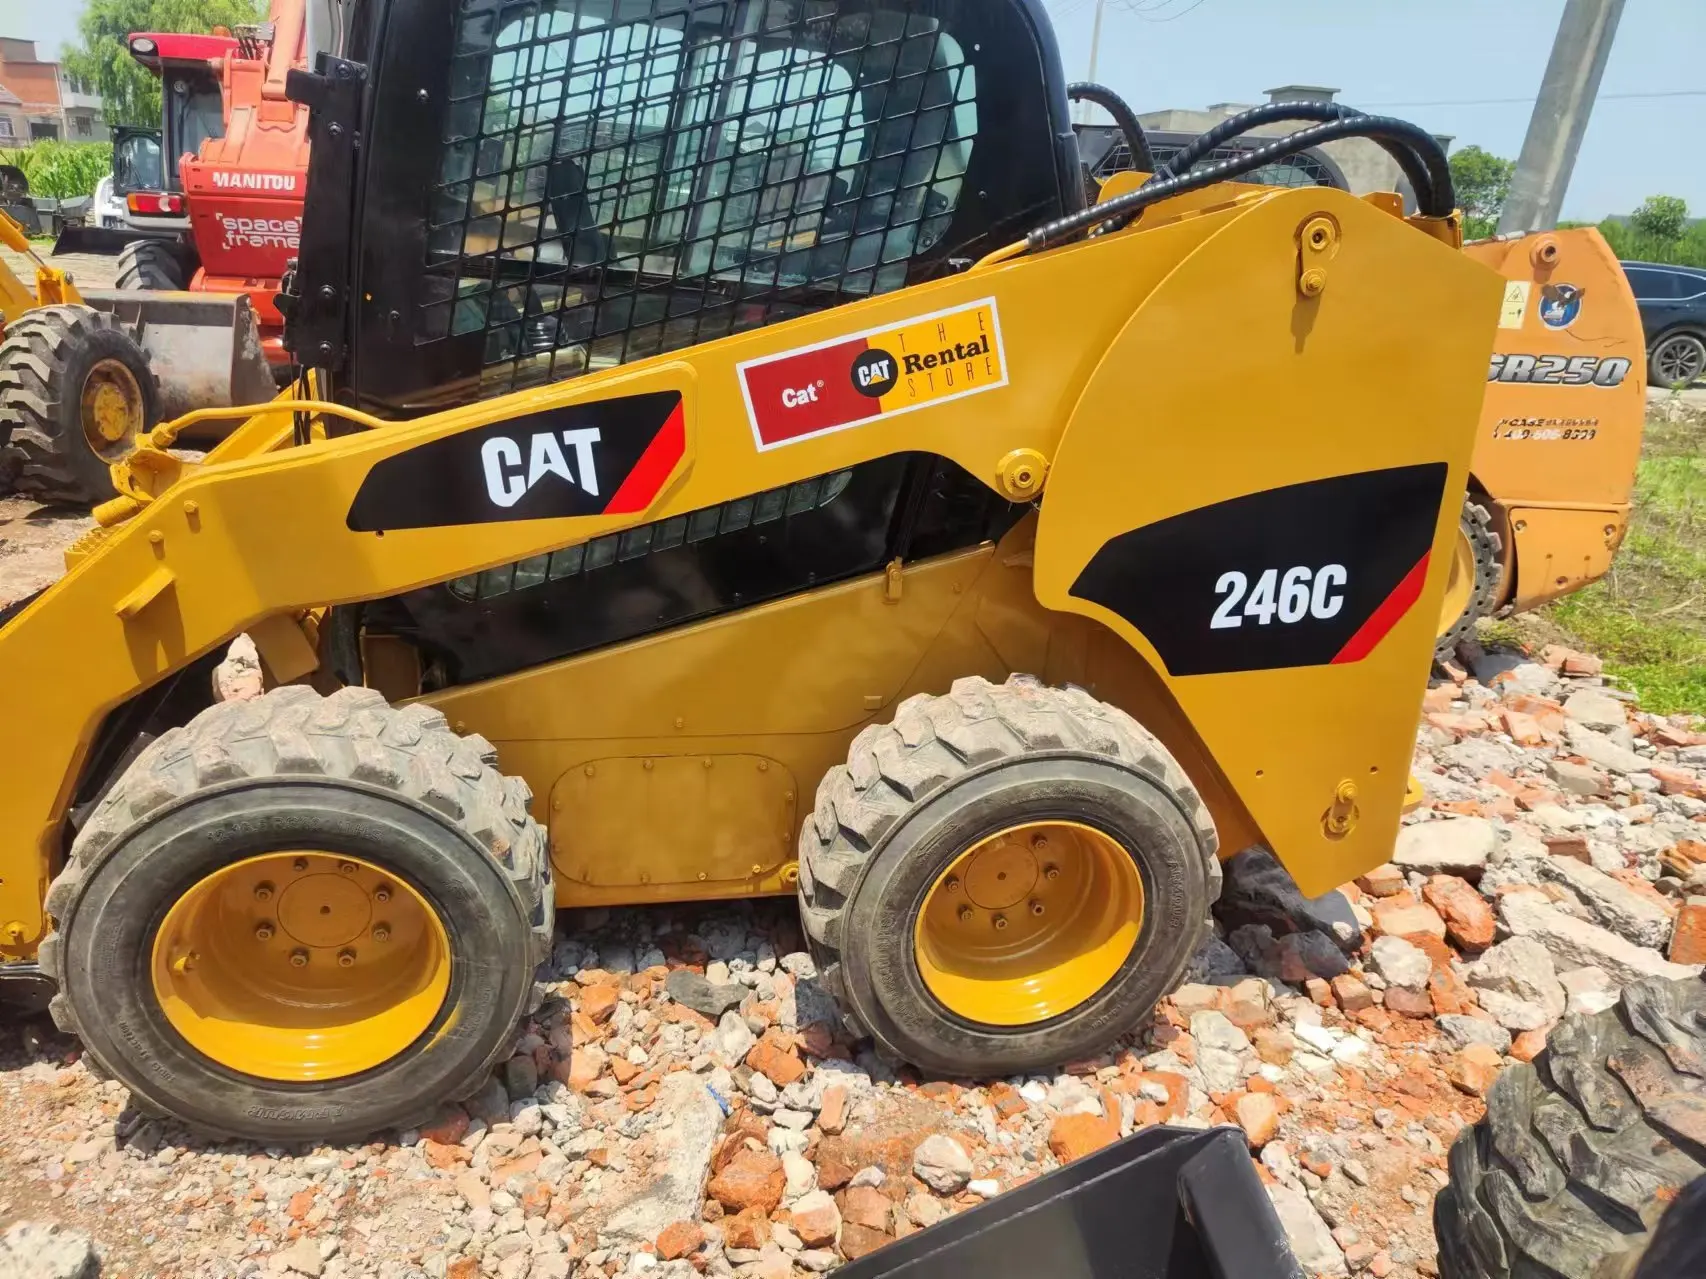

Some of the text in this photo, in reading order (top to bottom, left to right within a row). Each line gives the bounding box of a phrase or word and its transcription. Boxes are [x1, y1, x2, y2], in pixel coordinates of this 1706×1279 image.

[212, 171, 296, 191] MANITOU
[222, 217, 299, 233] space
[225, 230, 300, 249] frame
[897, 311, 985, 353] THE
[858, 359, 890, 387] CAT
[902, 334, 990, 375] Rental
[907, 356, 993, 398] STORE
[481, 427, 601, 508] CAT
[1210, 563, 1347, 630] 246C
